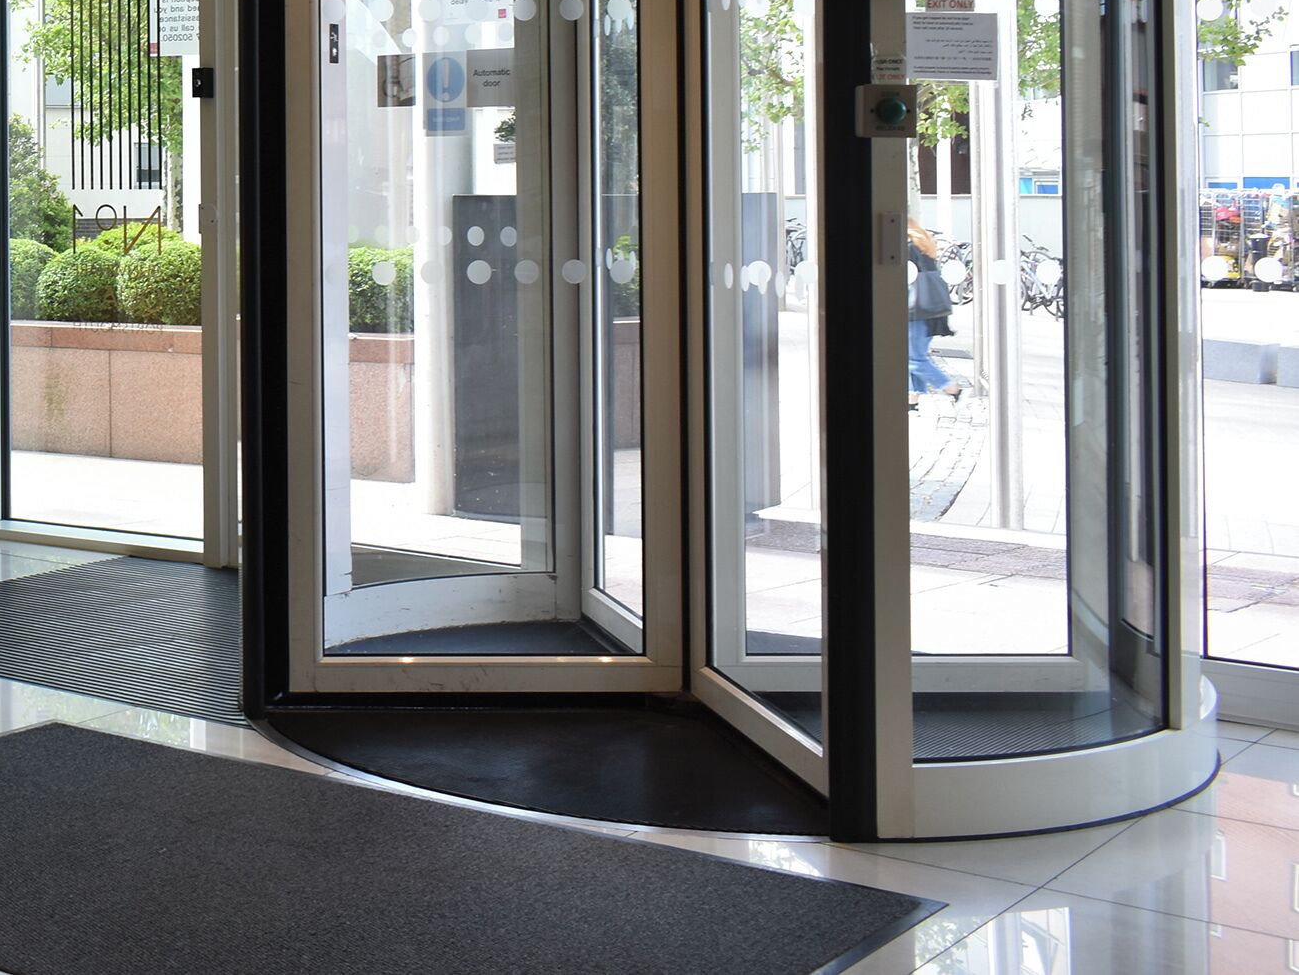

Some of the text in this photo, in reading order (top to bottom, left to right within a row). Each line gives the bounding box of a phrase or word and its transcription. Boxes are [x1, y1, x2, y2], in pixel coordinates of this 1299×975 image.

[927, 0, 974, 9] EXIT ONLY
[473, 68, 511, 77] Automatic
